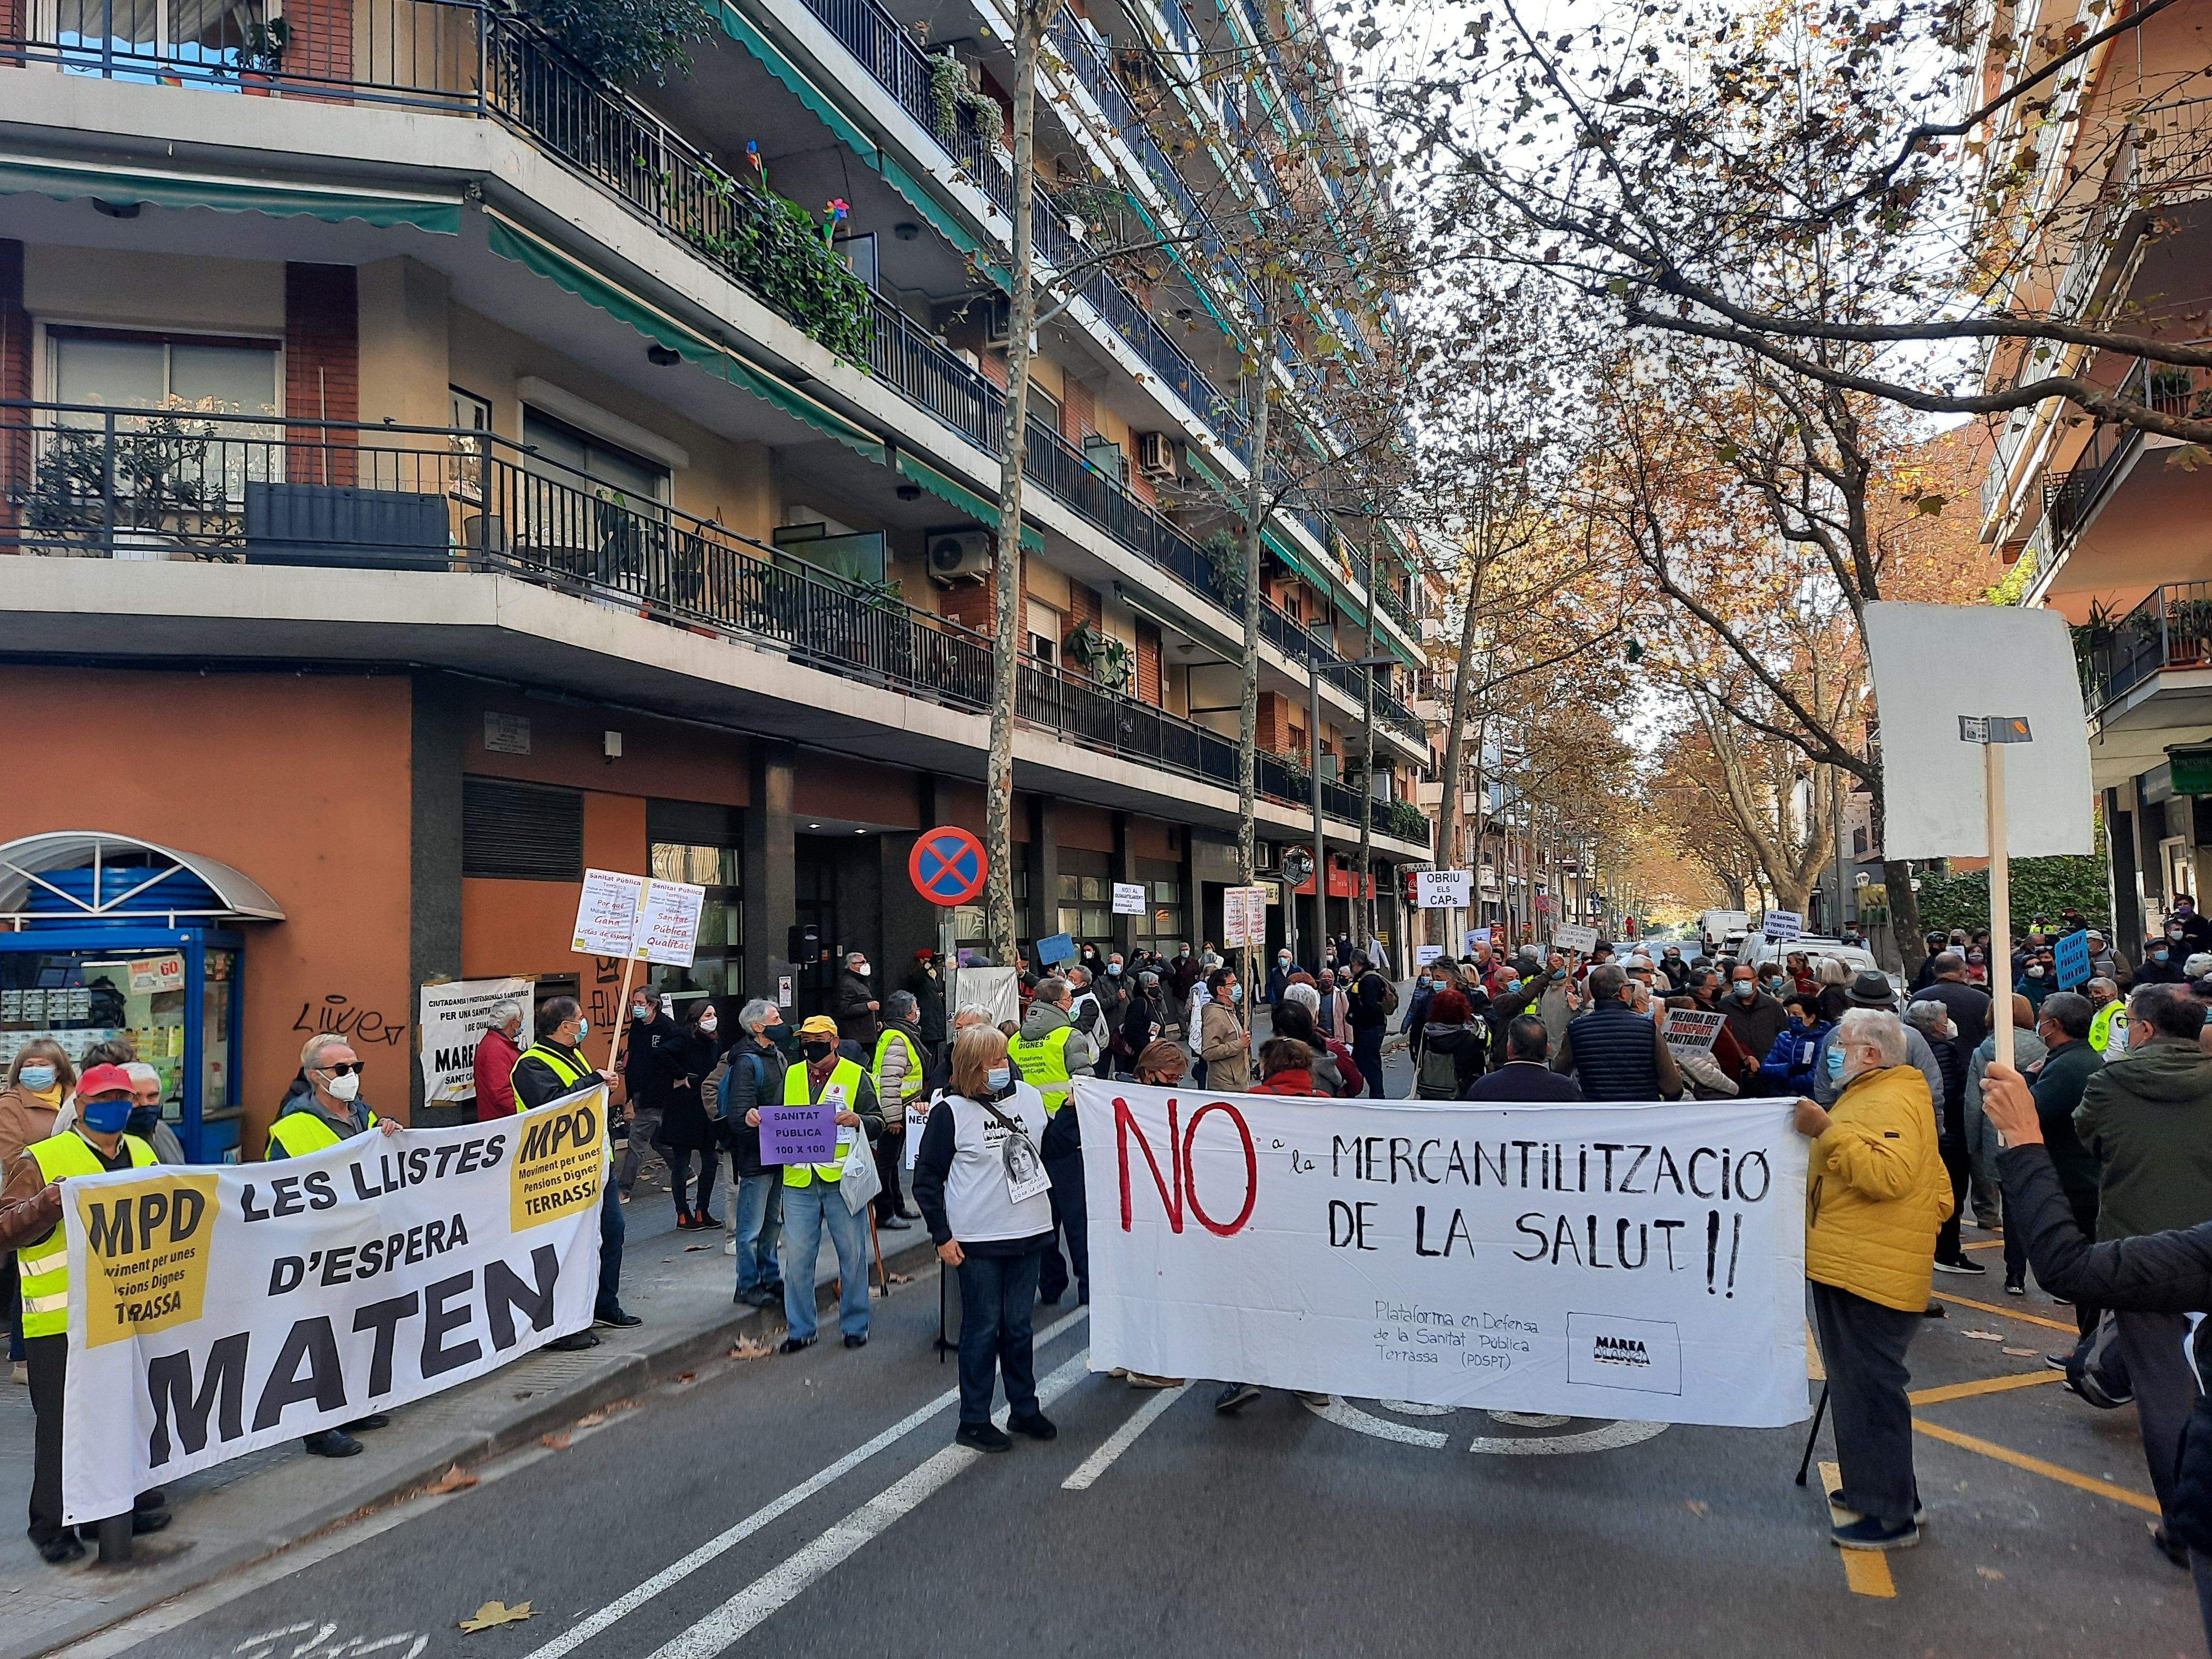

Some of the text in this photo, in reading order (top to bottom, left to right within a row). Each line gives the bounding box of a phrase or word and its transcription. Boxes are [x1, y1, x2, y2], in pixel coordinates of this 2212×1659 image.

[589, 873, 641, 886] Sanitat Pública
[1427, 873, 1460, 883] OBRIU
[678, 887, 702, 895] Pública
[1430, 895, 1458, 905] CAPs
[595, 916, 620, 926] Gana
[657, 913, 688, 923] Sanitat
[653, 925, 687, 936] Pública
[647, 937, 690, 950] Qualitat
[440, 1011, 456, 1021] PER
[459, 1009, 471, 1019] UNA
[1670, 1011, 1720, 1026] MEJORA DEL
[468, 1022, 475, 1031] DE
[1670, 1022, 1714, 1036] TRANSPORTE
[1019, 1041, 1044, 1050] DIGNES
[435, 1043, 479, 1073] MARE
[445, 1073, 465, 1084] SANT
[774, 1112, 820, 1120] SANITAT
[519, 1107, 596, 1164] MPD
[775, 1128, 822, 1138] PÚBLICA
[775, 1146, 793, 1154] 100
[807, 1145, 826, 1153] 100
[519, 1147, 600, 1180] Moviment per unes
[1112, 1097, 1316, 1237] NO a la
[240, 1134, 507, 1224] LES LLISTES
[524, 1164, 597, 1193] Pensions Dignes
[525, 1180, 596, 1216] TERRASSA
[88, 1189, 205, 1258] MPD
[1328, 1199, 1379, 1251] DE
[1416, 1206, 1475, 1259] LA
[152, 1254, 168, 1272] per
[170, 1248, 195, 1262] unes
[268, 1212, 469, 1297] D'ESPERA
[152, 1270, 185, 1289] Dignes
[1375, 1300, 1539, 1333] Plataforma en Defensa
[1374, 1328, 1389, 1340] de
[1397, 1327, 1409, 1342] la
[1416, 1328, 1466, 1348] Sanitat
[1596, 1336, 1646, 1352] MAREA
[148, 1243, 557, 1469] MATEN
[1375, 1345, 1511, 1371] Terrassa (PDSPT)
[1594, 1347, 1651, 1365] BLANCA
